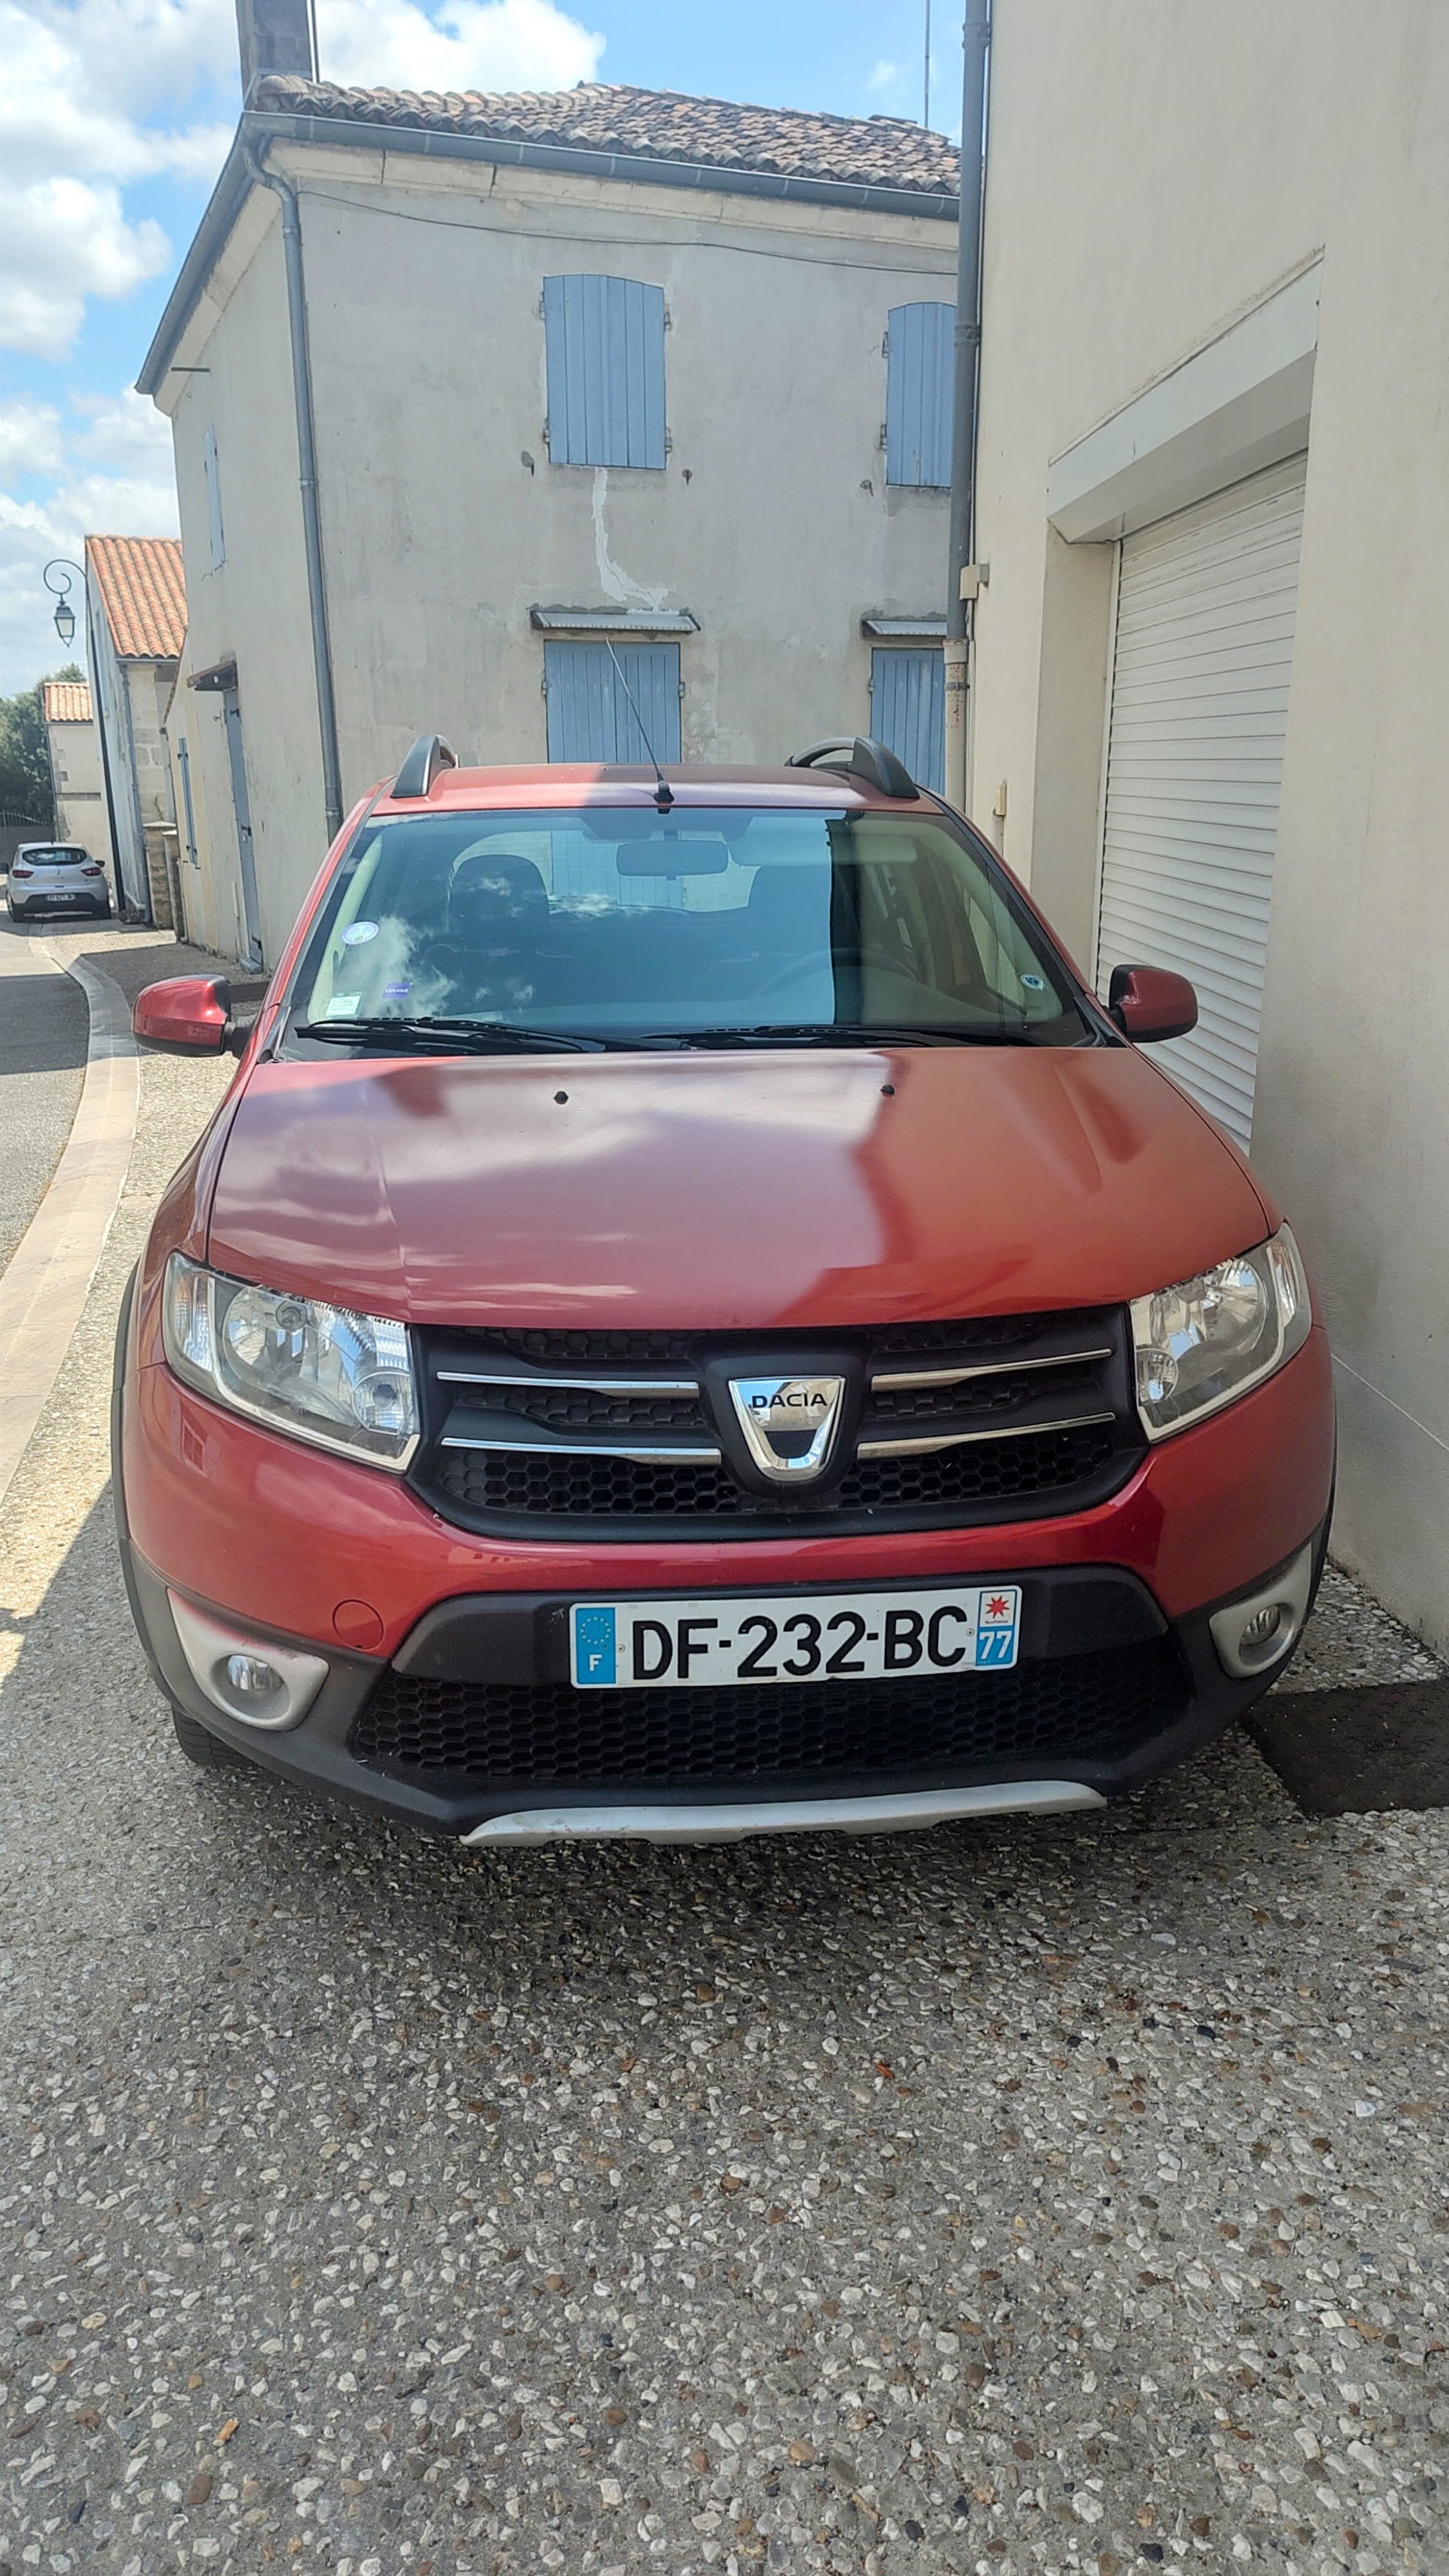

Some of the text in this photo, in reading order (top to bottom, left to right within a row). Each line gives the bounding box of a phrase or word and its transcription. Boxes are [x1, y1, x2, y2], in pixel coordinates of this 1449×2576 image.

[752, 1393, 828, 1408] DACIA
[632, 1605, 968, 1680] DF-232-BC
[979, 1631, 1012, 1660] 77
[589, 1654, 602, 1672] F
